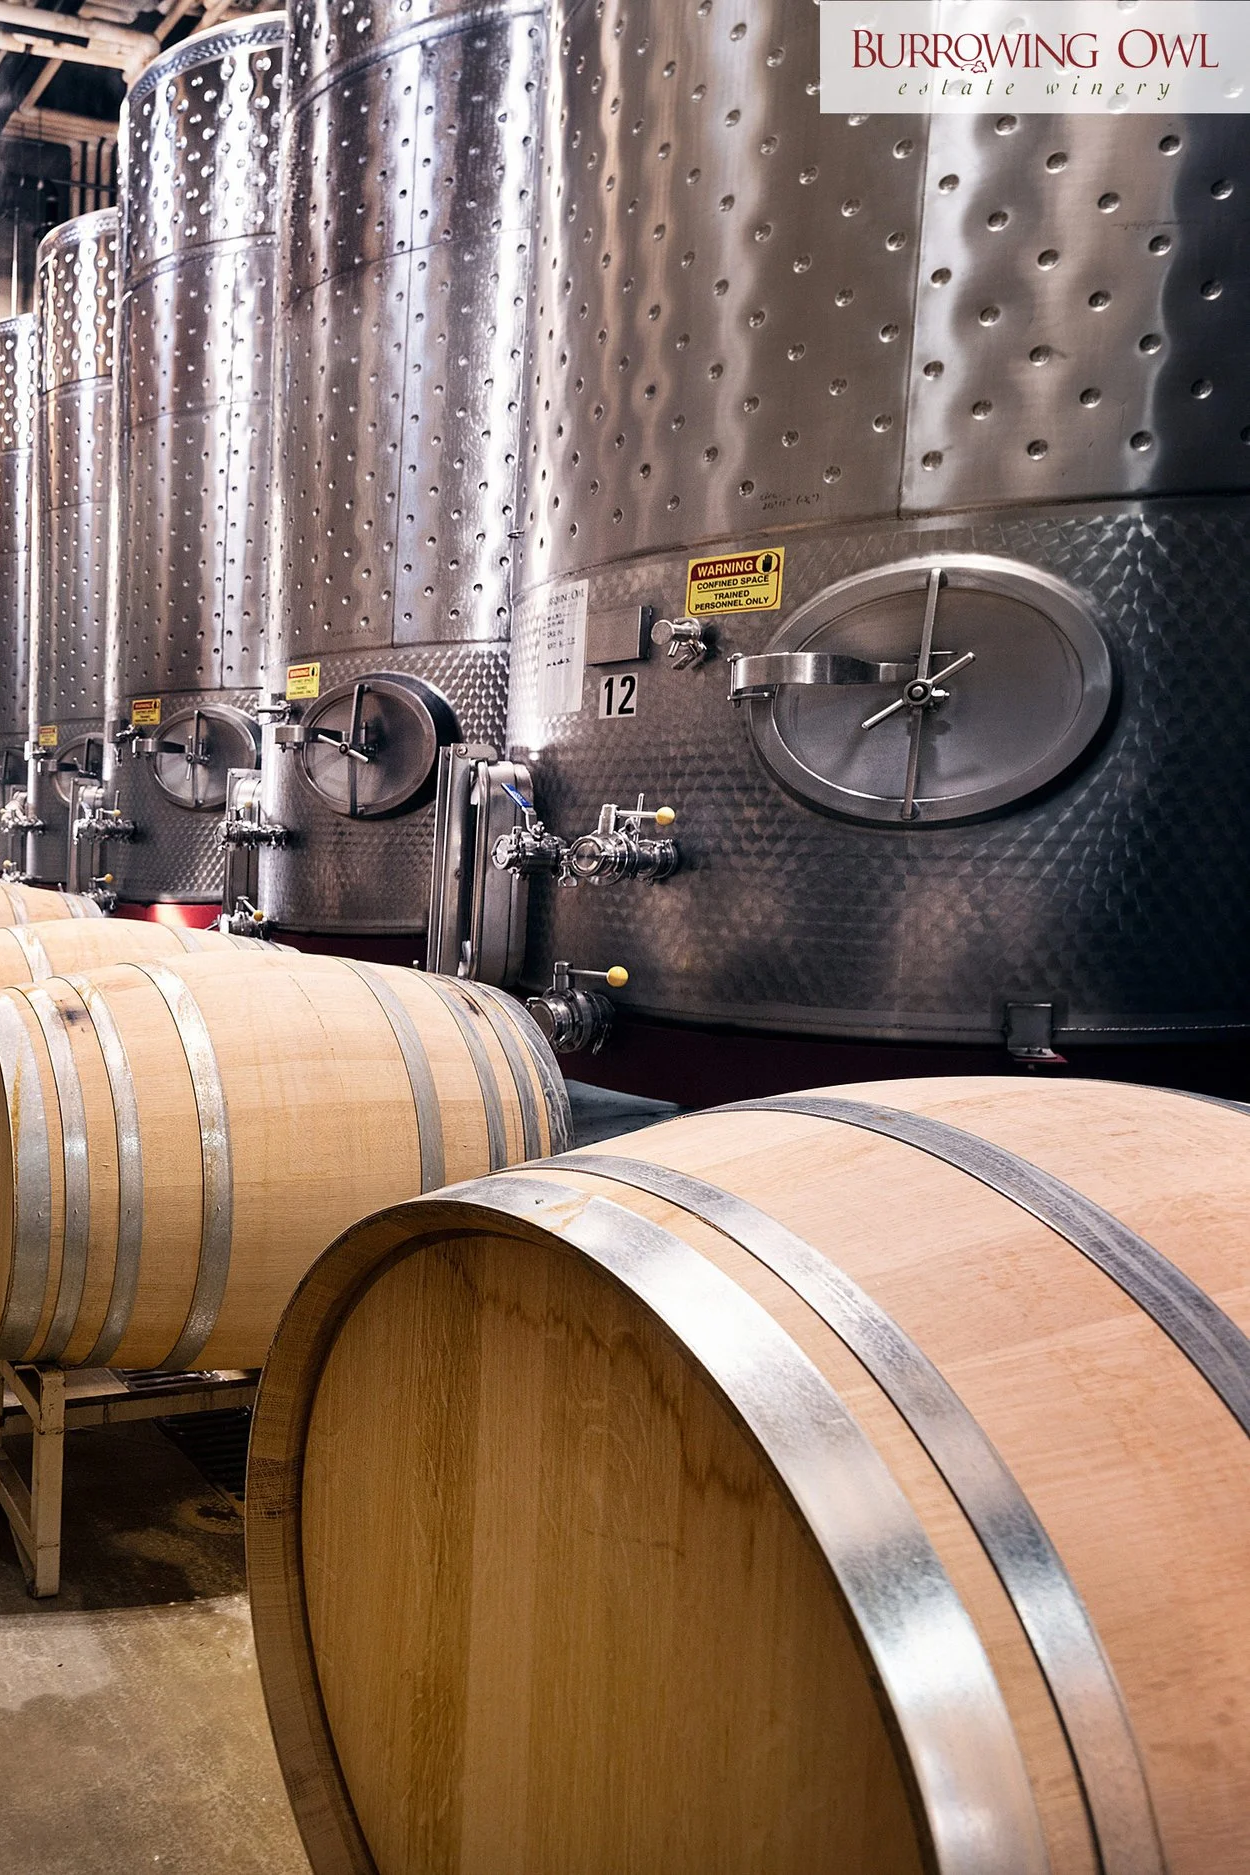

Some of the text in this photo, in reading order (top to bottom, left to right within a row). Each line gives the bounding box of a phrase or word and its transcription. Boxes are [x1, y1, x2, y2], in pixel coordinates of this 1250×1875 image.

[697, 560, 753, 577] WARNING
[697, 575, 769, 590] CONFINED SPACE
[714, 590, 750, 600] TRAINED
[695, 597, 769, 610] PERSONNEL ONLY
[604, 675, 636, 716] 12
